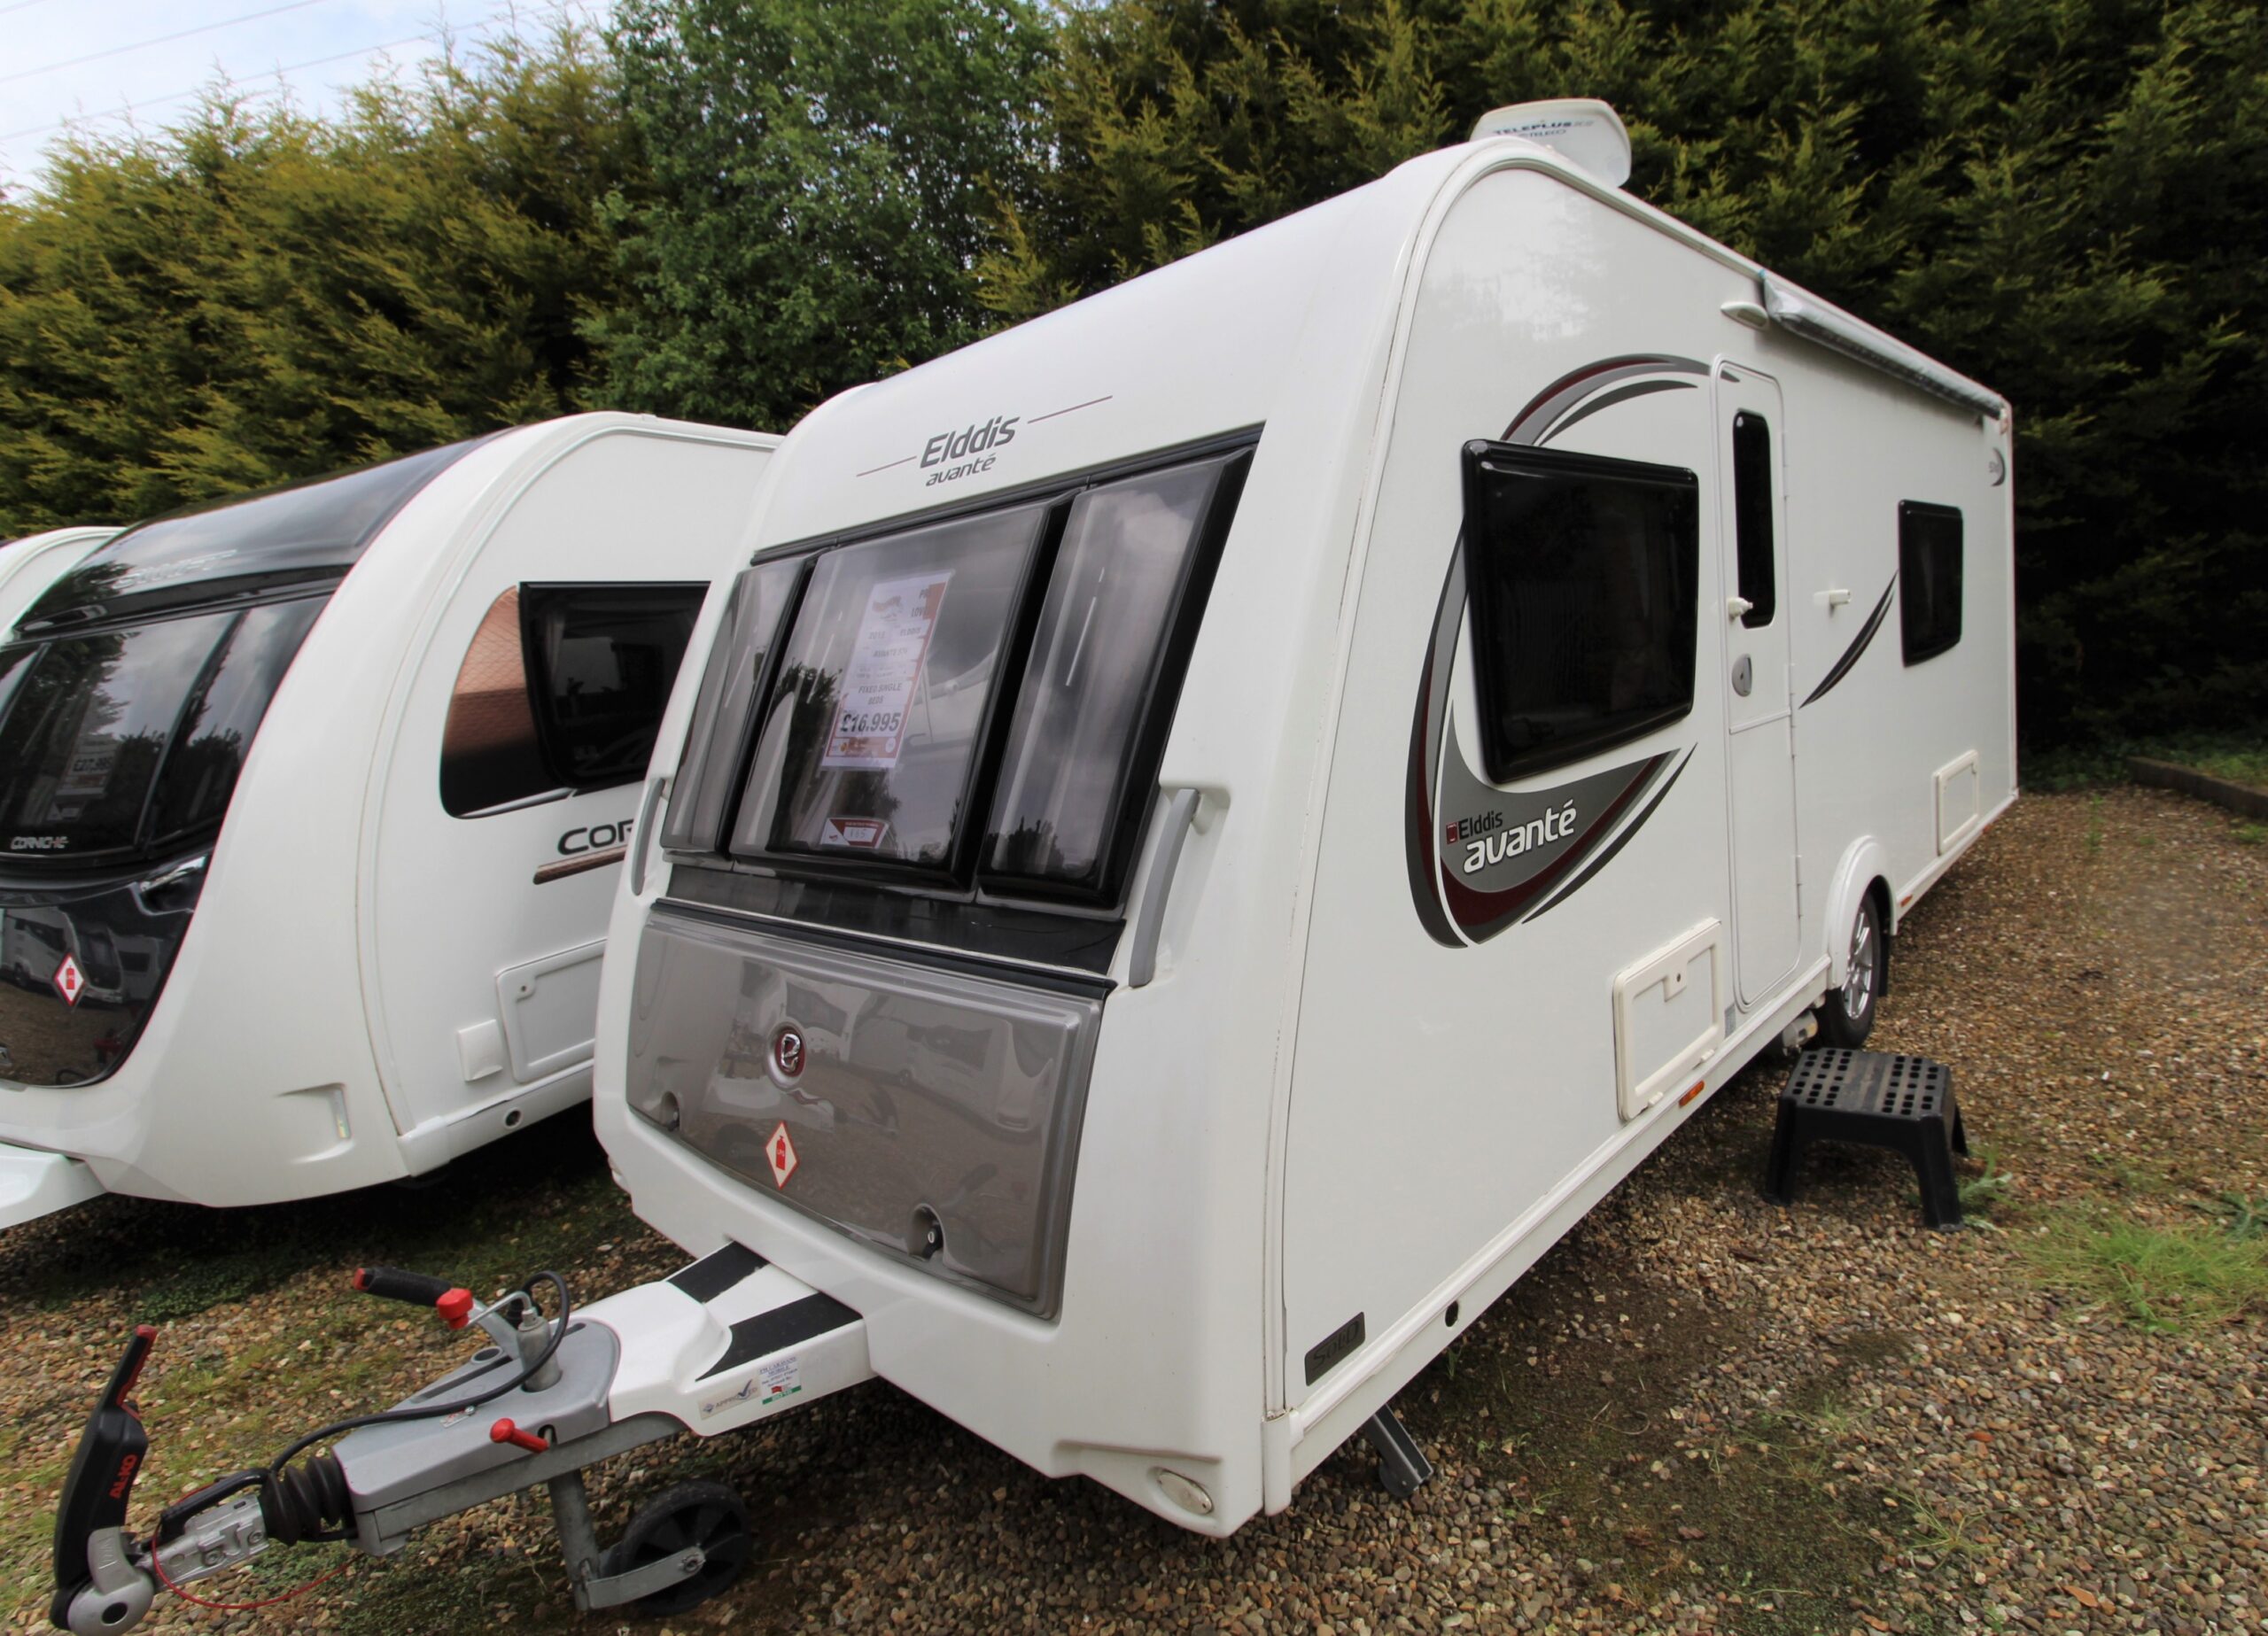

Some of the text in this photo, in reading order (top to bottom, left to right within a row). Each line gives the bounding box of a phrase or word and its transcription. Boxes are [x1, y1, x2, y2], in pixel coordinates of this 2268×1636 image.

[920, 415, 1021, 469] Elddis
[925, 452, 997, 487] avanté
[840, 712, 902, 733] £16.995
[1457, 810, 1504, 841] Elddis
[1463, 798, 1578, 874] avanté
